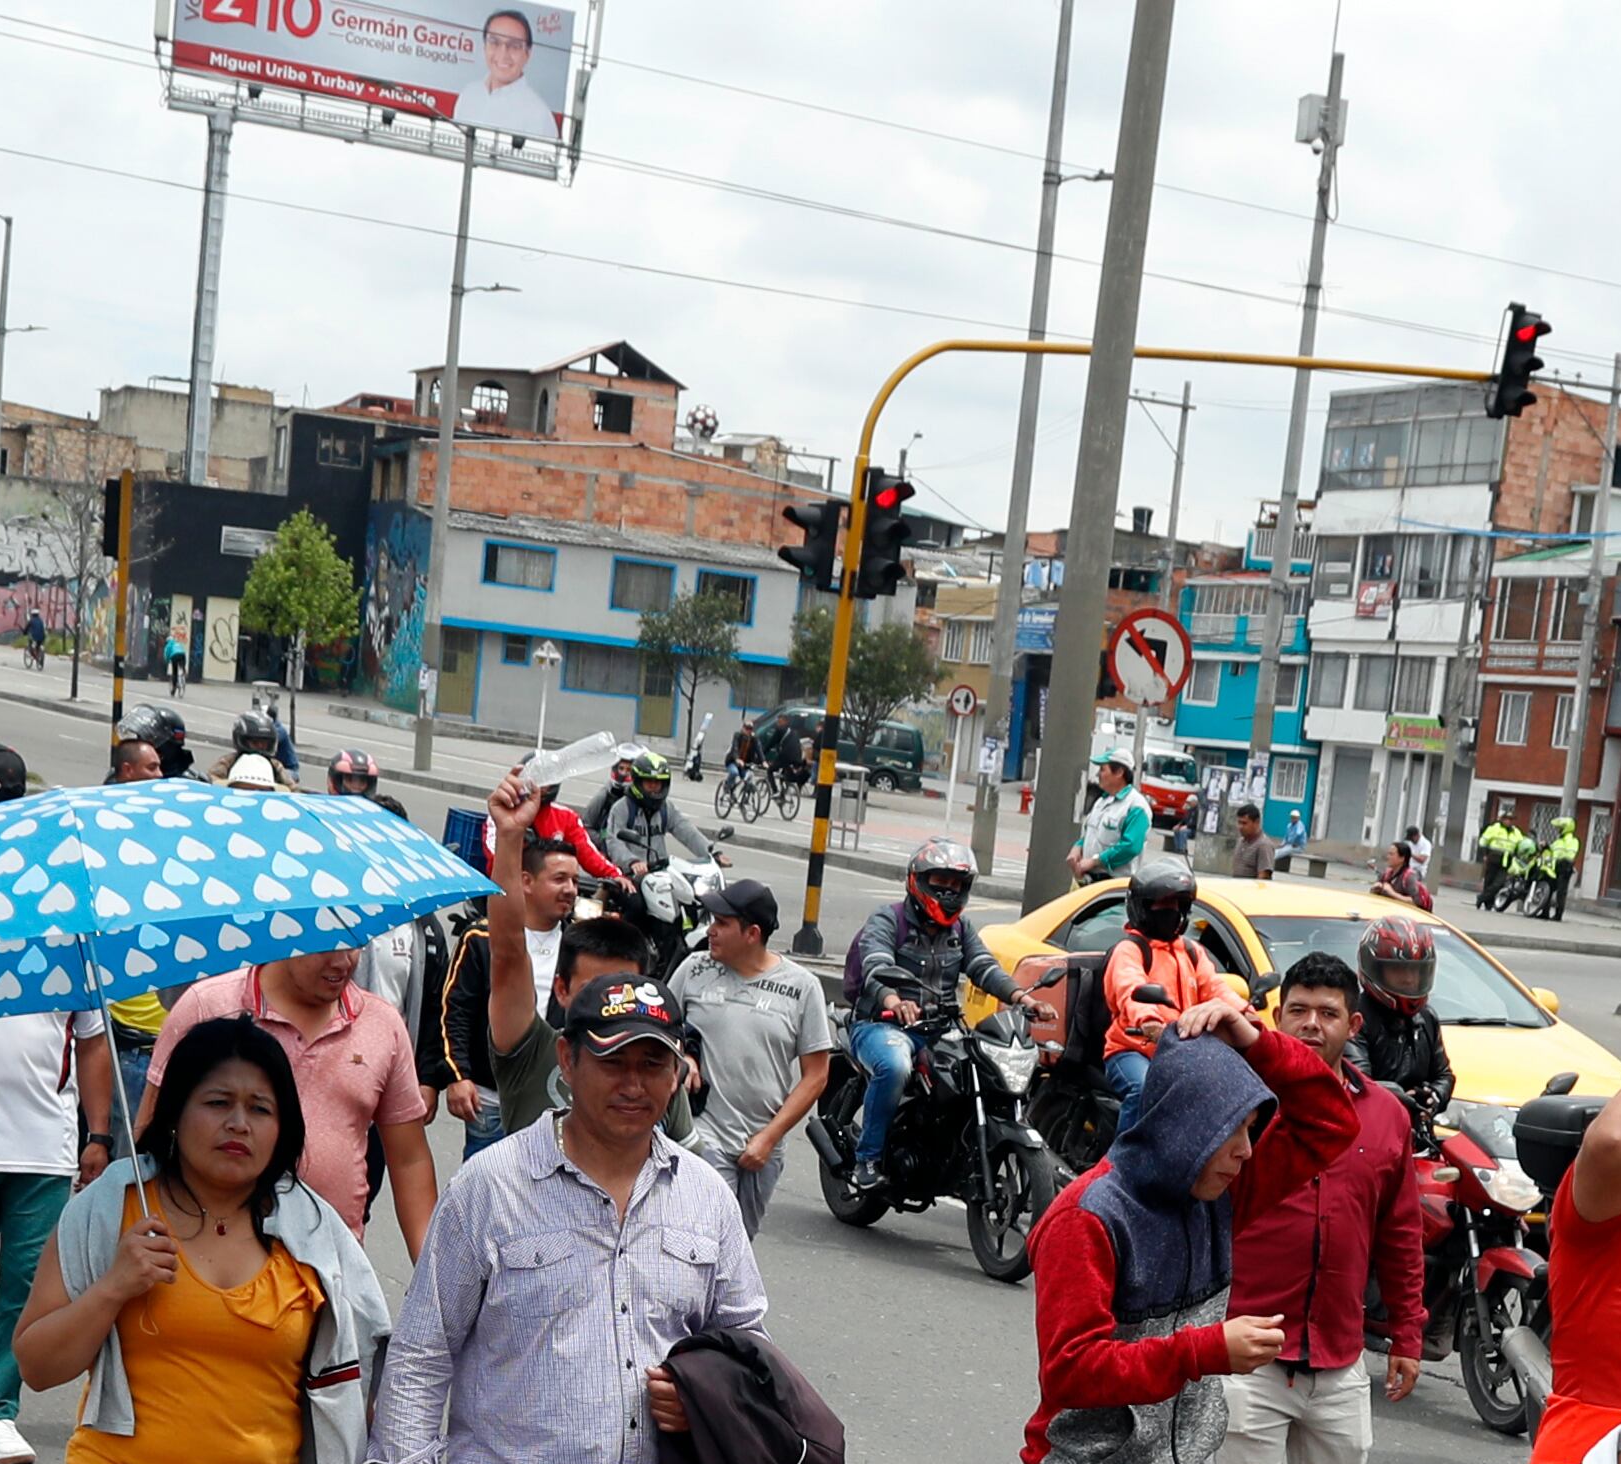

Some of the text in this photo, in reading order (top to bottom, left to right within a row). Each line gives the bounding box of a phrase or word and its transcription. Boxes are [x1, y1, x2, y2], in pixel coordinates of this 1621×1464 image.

[331, 8, 474, 53] Germán García
[345, 32, 458, 64] Concejal de Bogotá
[209, 51, 261, 74] Miguel
[265, 61, 307, 82] Uribe
[311, 71, 365, 96] Turbay
[379, 85, 436, 107] Alcalde
[392, 937, 406, 952] 19
[747, 978, 802, 1001] MERICAN
